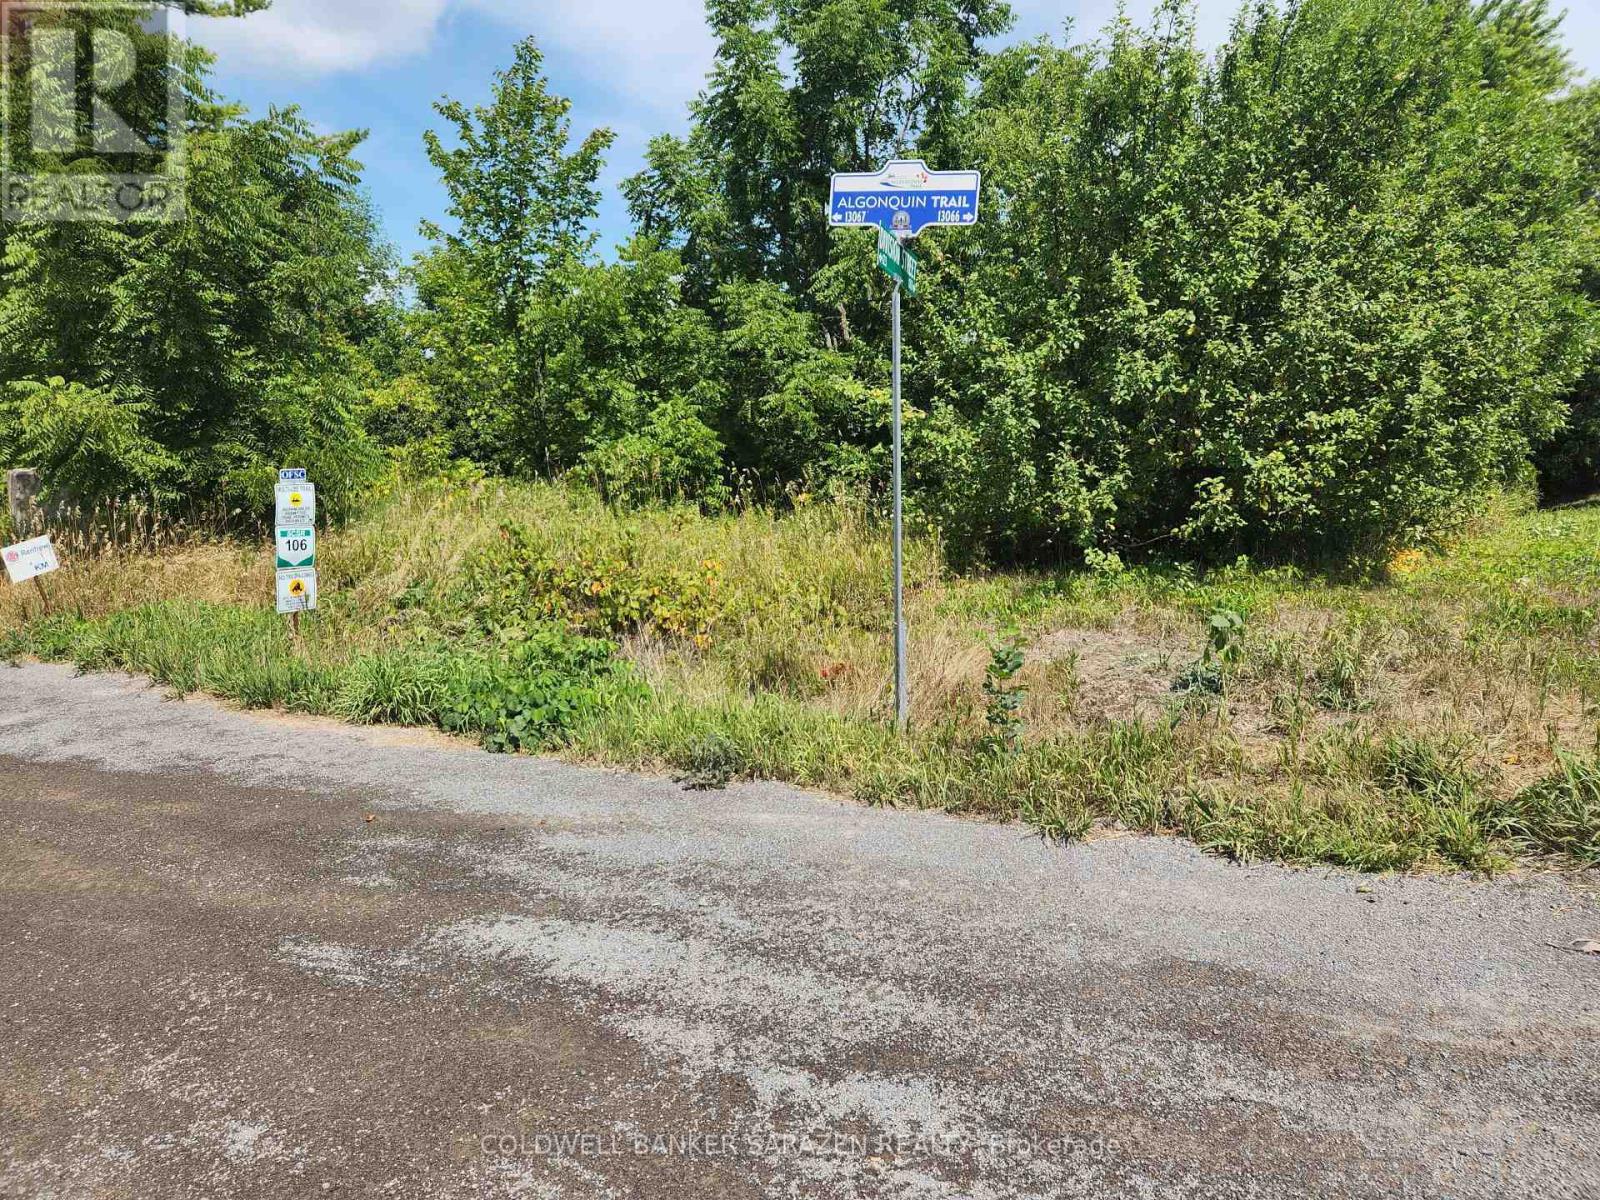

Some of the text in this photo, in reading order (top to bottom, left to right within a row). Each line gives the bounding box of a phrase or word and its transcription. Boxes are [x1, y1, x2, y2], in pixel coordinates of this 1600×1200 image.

[837, 196, 970, 209] ALGONQUIN TRAIL
[845, 210, 866, 222] 13067
[938, 210, 960, 222] 13066
[281, 470, 305, 479] OFSC
[285, 539, 307, 551] 106
